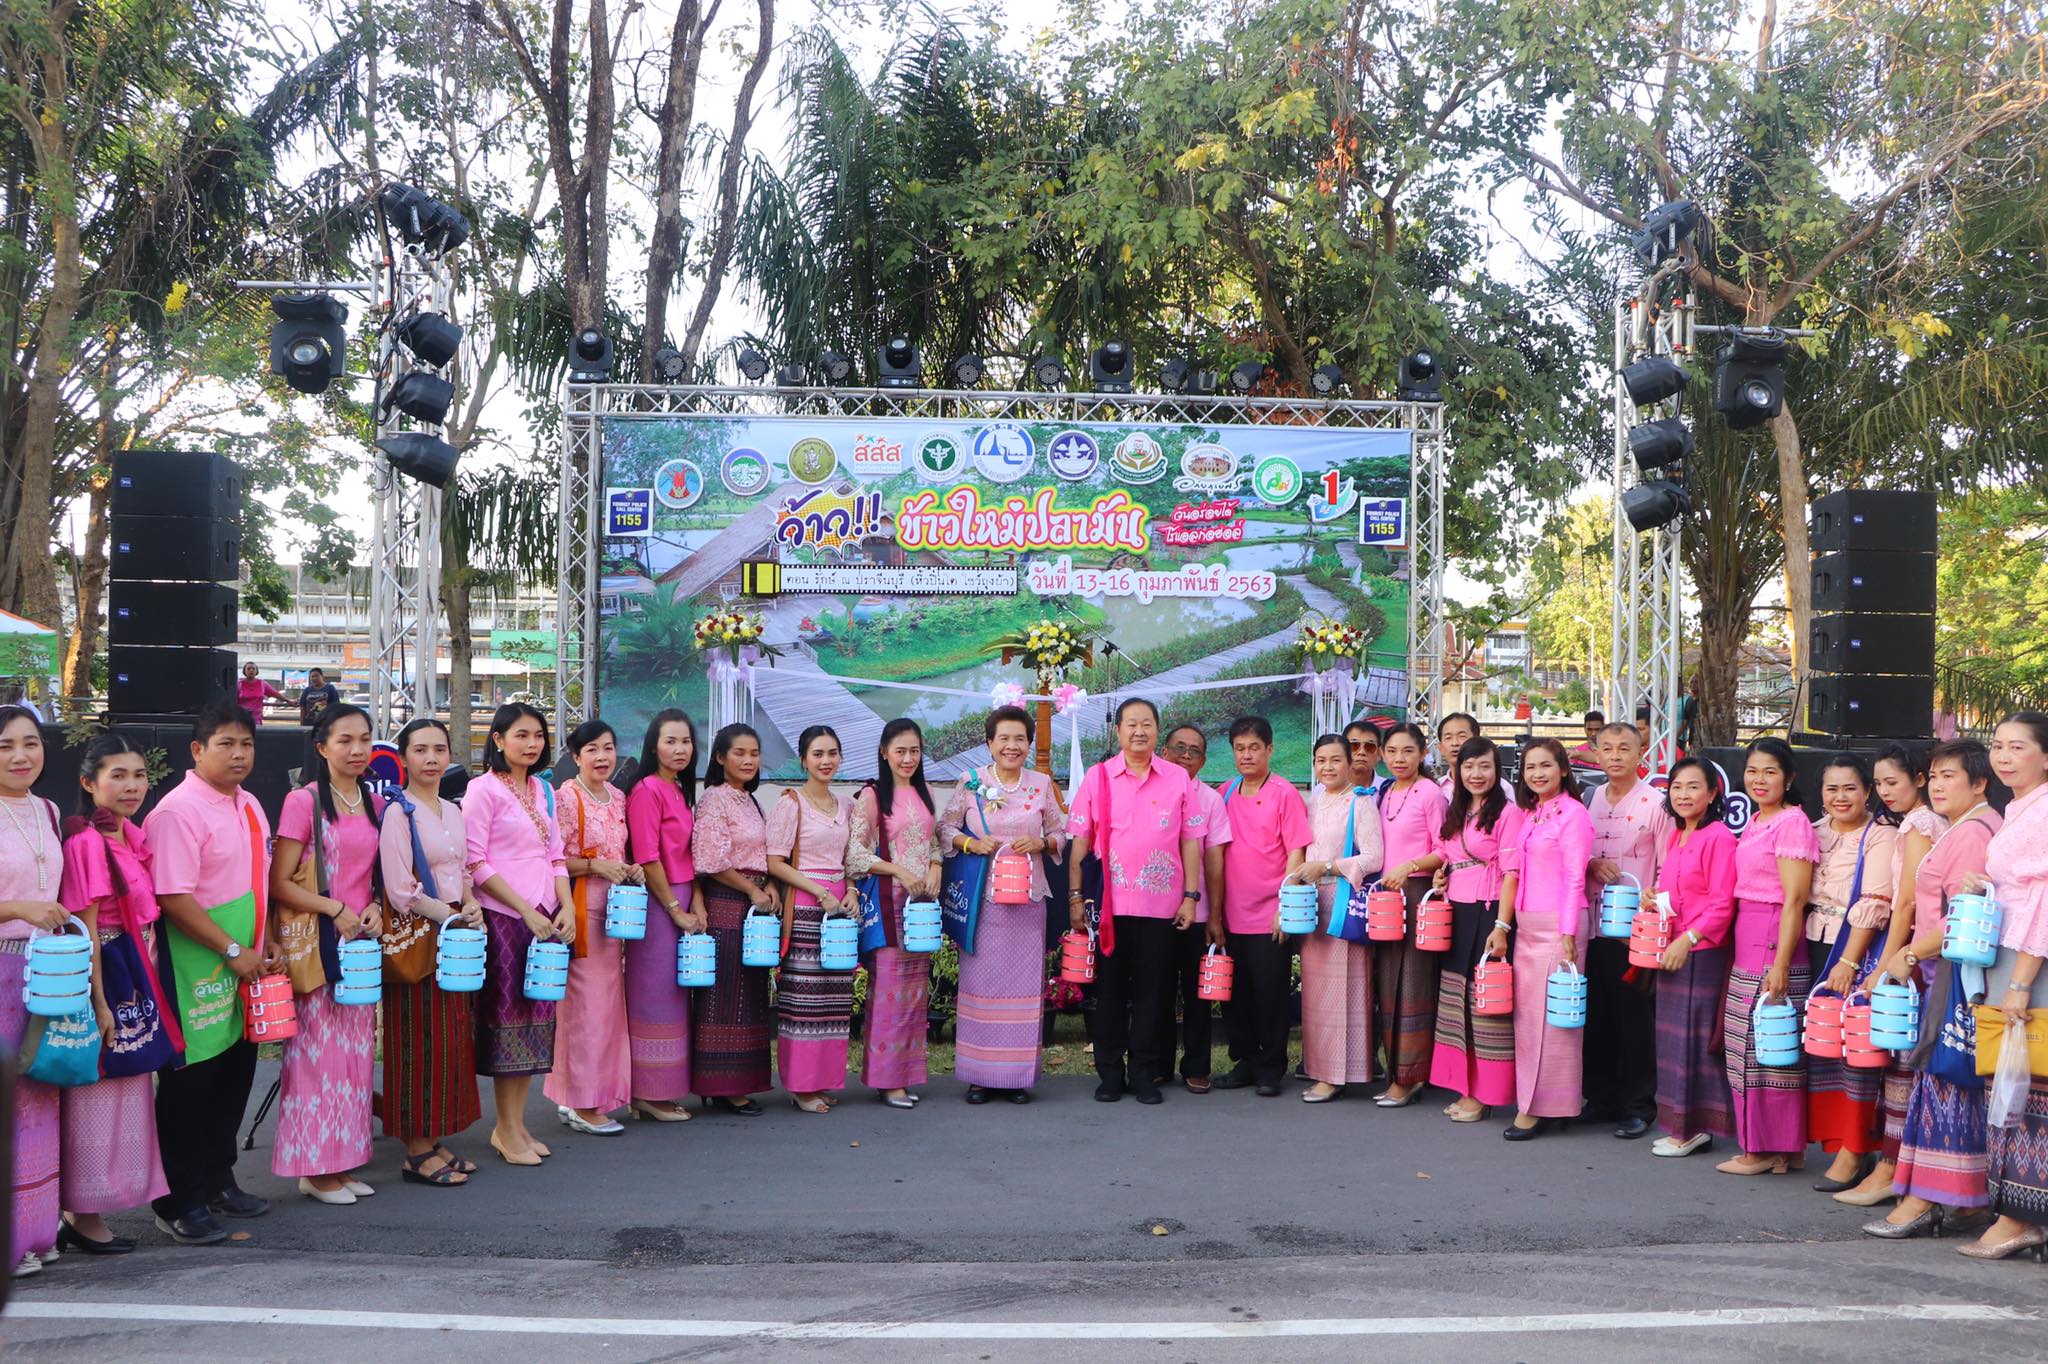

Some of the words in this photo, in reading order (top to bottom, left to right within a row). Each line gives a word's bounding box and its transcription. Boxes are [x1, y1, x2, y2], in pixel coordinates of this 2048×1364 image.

[615, 514, 642, 526] 1155
[1369, 523, 1395, 535] 1155
[1031, 560, 1067, 589] วันที่
[1076, 574, 1130, 591] 13-16
[1138, 569, 1221, 598] กุมภาพันธ์
[1228, 575, 1273, 594] 2563
